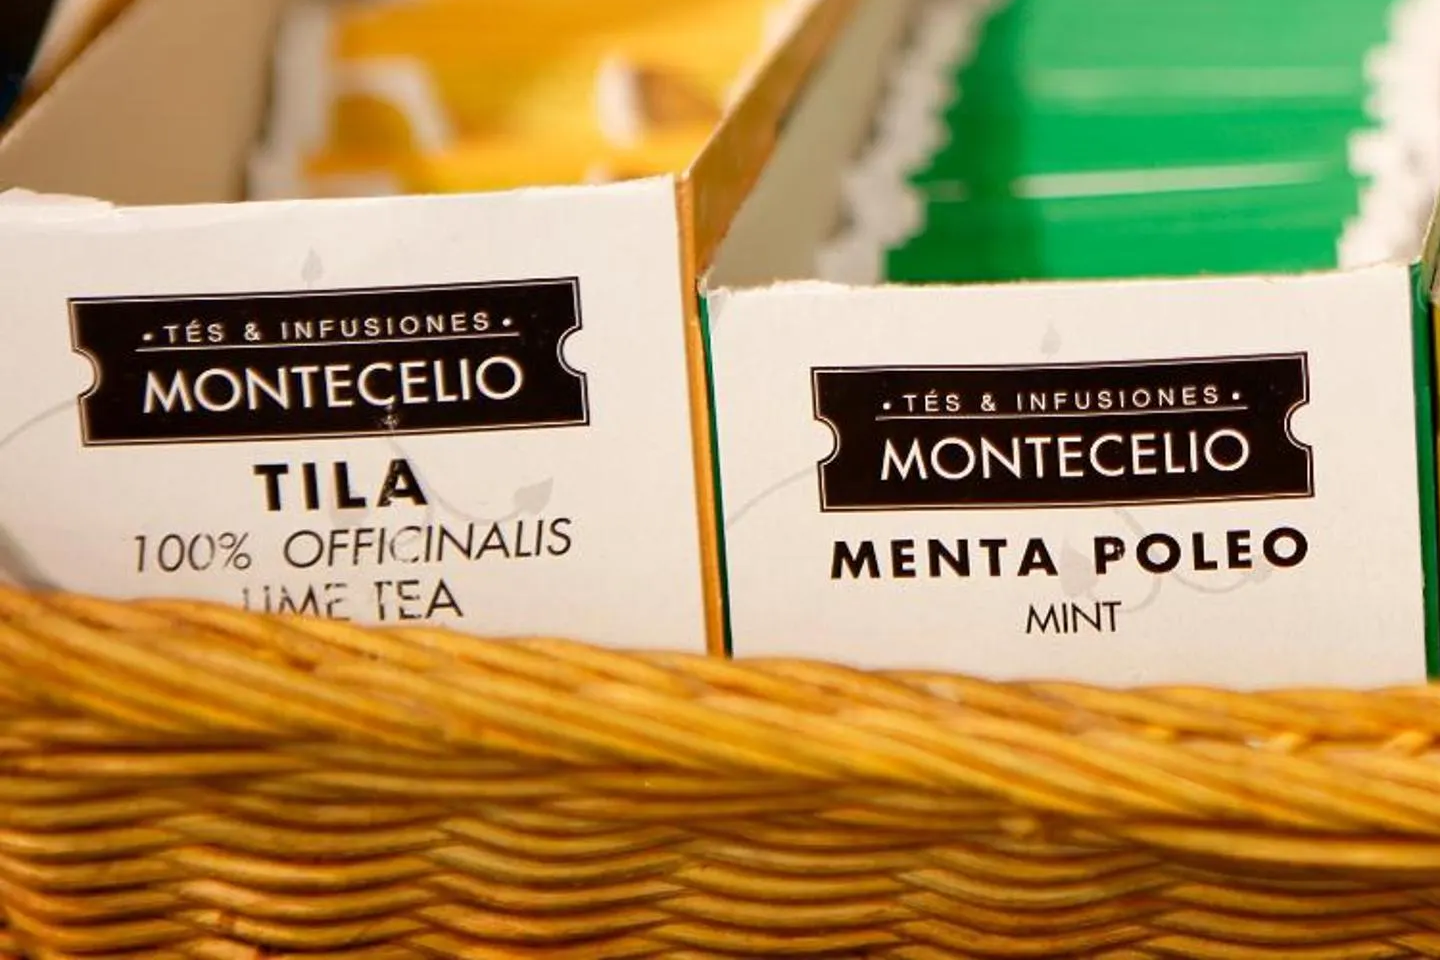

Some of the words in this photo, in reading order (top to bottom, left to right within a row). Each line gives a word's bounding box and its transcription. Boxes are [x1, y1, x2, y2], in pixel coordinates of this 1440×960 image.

[162, 320, 227, 344] TÉS
[243, 322, 263, 342] &
[280, 311, 491, 339] INFUSIONES
[142, 355, 525, 414] MONTECELIO
[902, 389, 962, 414] TÉS
[980, 393, 997, 413] &
[1016, 385, 1219, 411] INFUSIONES
[880, 428, 1250, 481] MONTECELIO
[253, 458, 429, 512] TILA
[135, 531, 253, 574] 100%
[283, 516, 573, 570] OFFICINALIS
[830, 537, 1059, 580] MENTA
[1093, 526, 1310, 576] POLEO
[373, 578, 464, 621] TEA
[1025, 600, 1122, 635] MINT
